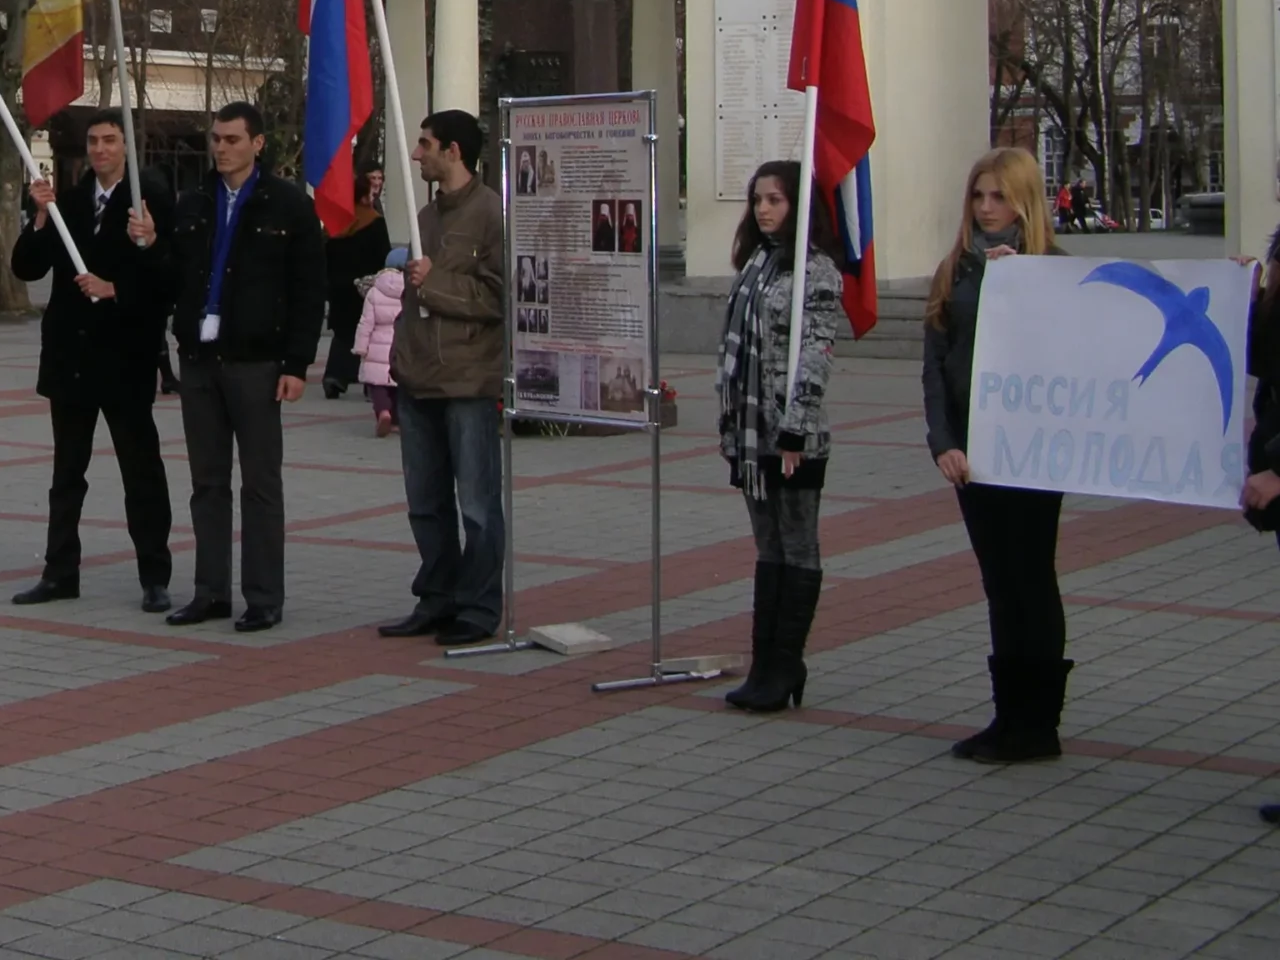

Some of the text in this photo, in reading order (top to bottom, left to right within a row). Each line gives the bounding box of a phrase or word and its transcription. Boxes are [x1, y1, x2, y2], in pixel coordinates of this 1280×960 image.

[515, 109, 641, 128] РУССКАЯ ПРАВОСЛАВНАЯ ЦЕРКОВЬ
[978, 371, 1130, 421] РОССИЯ
[992, 425, 1242, 497] МОЛОДАЯ
